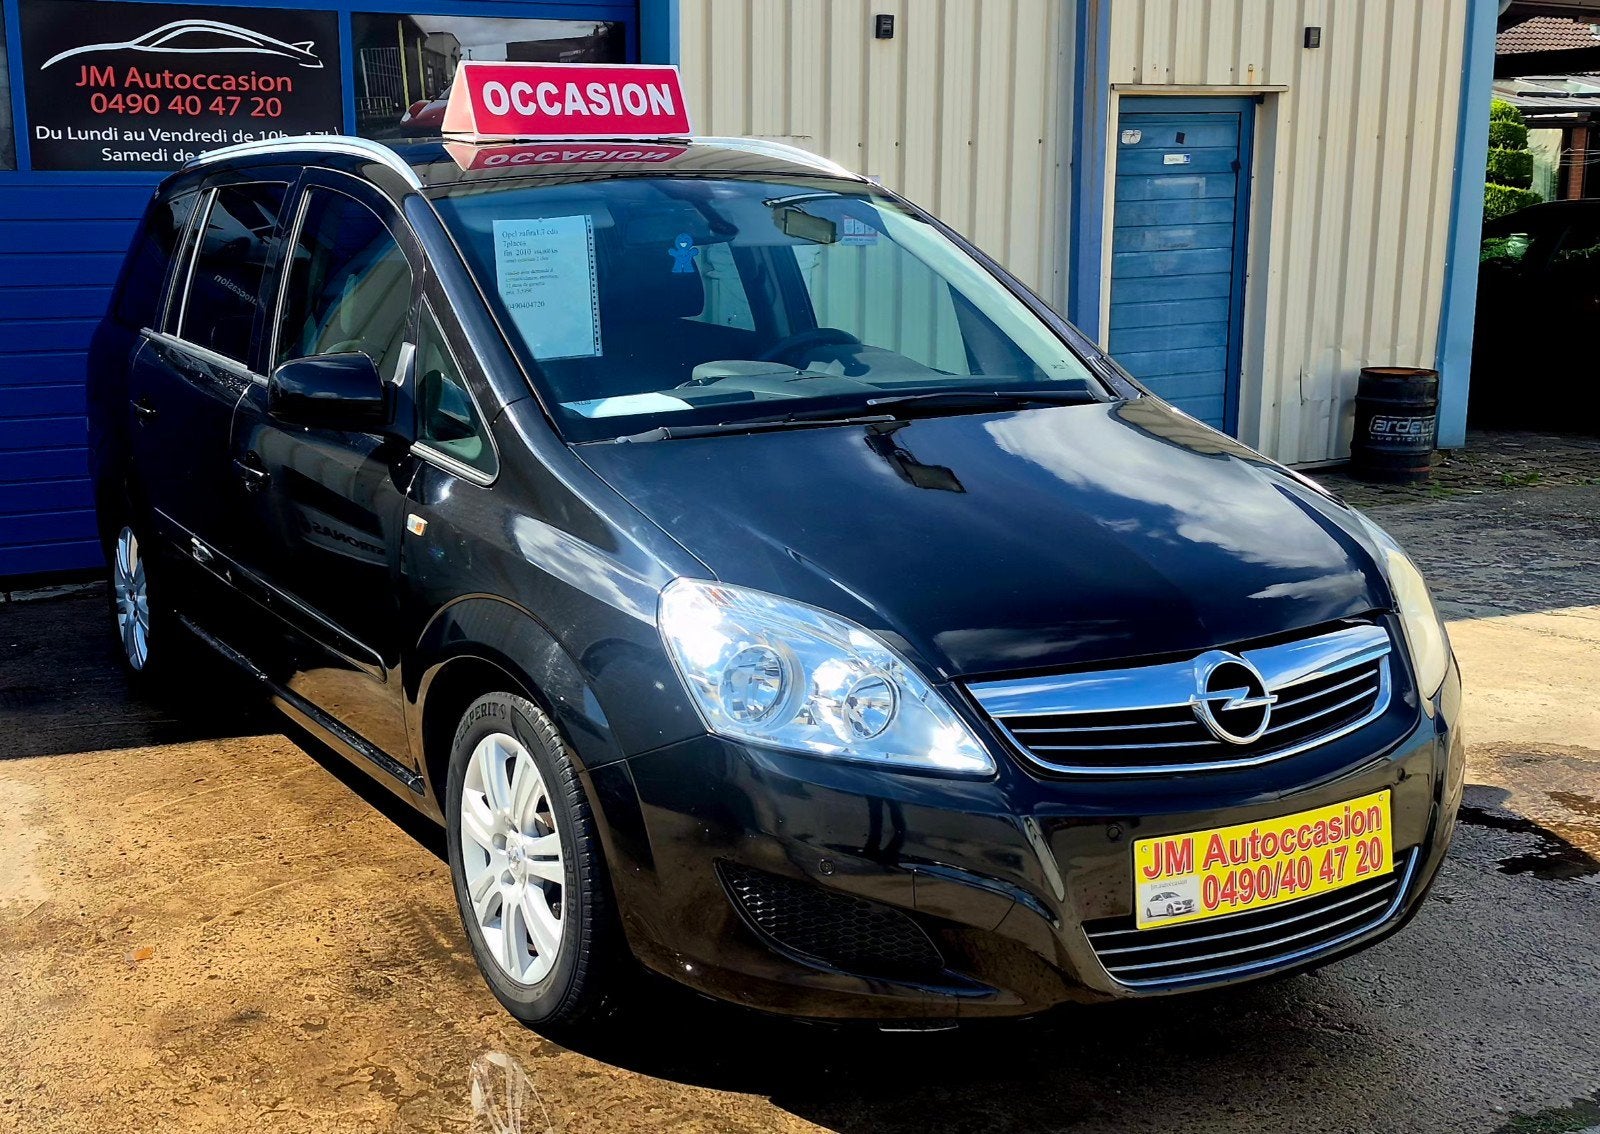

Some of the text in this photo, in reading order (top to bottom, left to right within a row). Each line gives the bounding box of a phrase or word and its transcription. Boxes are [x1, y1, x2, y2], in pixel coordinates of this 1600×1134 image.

[75, 65, 292, 92] JM Autoccasion
[90, 93, 282, 117] 0490 40 47 20
[482, 81, 675, 116] OCCASION
[36, 126, 62, 140] Du
[67, 126, 118, 141] Lundi
[124, 130, 145, 142] au
[148, 128, 227, 143] Vendredi
[232, 129, 254, 143] de
[102, 148, 195, 162] Samedi de
[516, 248, 532, 256] 2010
[1142, 805, 1382, 880] JM Autoccasion
[1202, 836, 1384, 911] 0490/40 47 20
